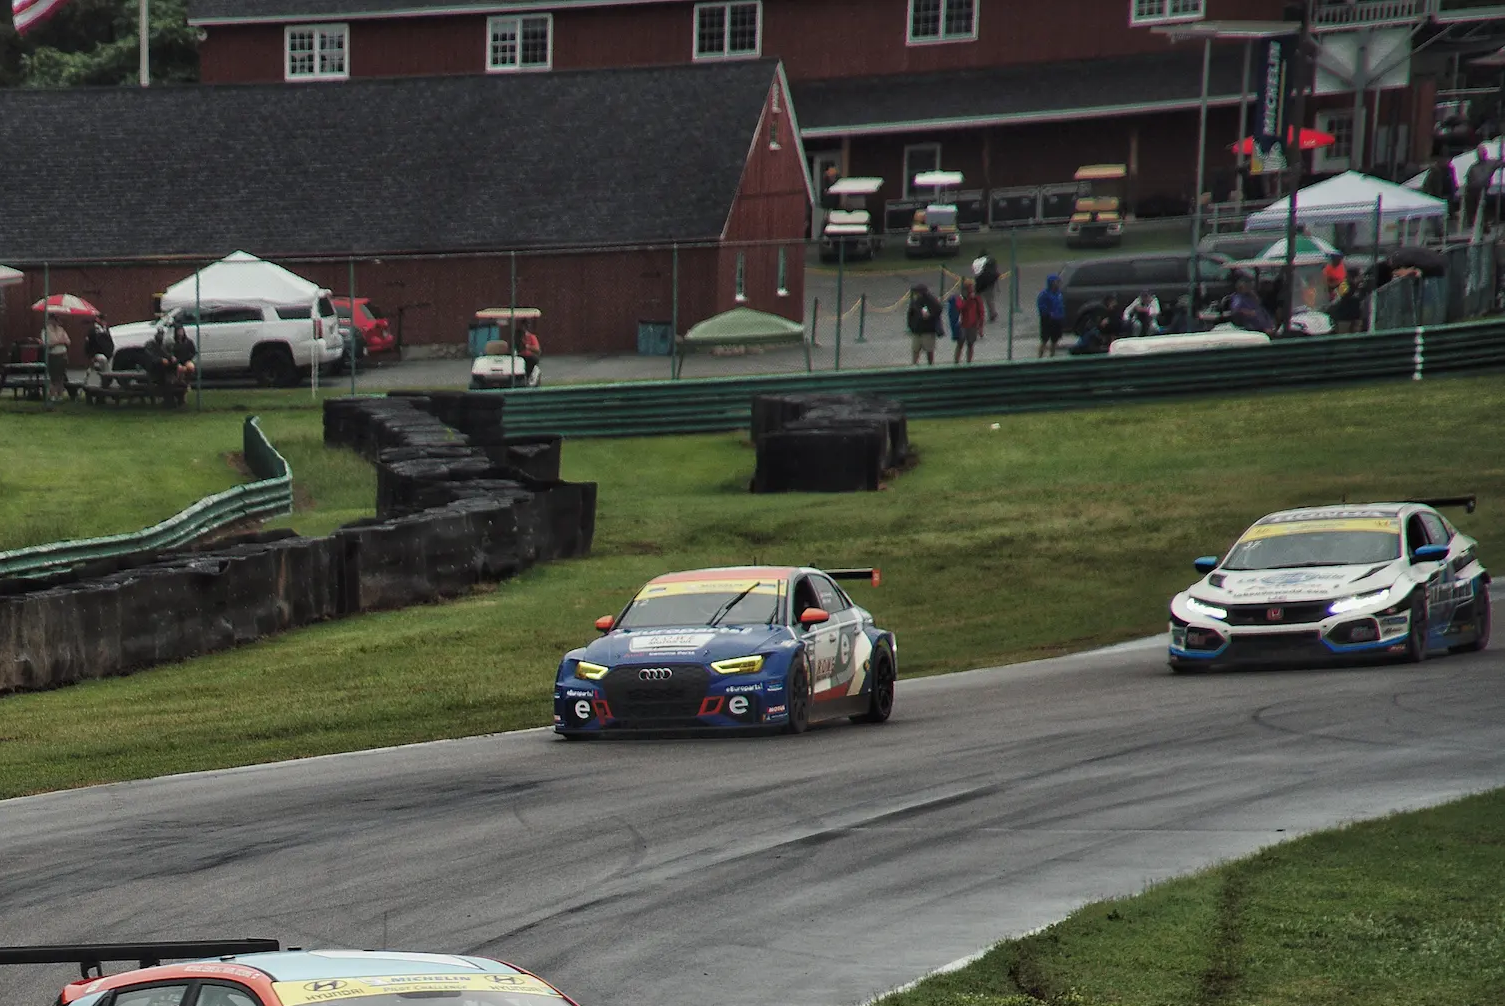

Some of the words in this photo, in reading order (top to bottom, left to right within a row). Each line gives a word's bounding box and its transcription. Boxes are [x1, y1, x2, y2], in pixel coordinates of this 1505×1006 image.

[1262, 40, 1281, 136] MICHELIN
[575, 700, 590, 719] e
[729, 695, 749, 714] e
[391, 975, 472, 983] MICHELIN
[305, 987, 365, 1002] HYUNDAI
[383, 985, 411, 993] PILOT
[490, 985, 543, 993] HYUNDAI
